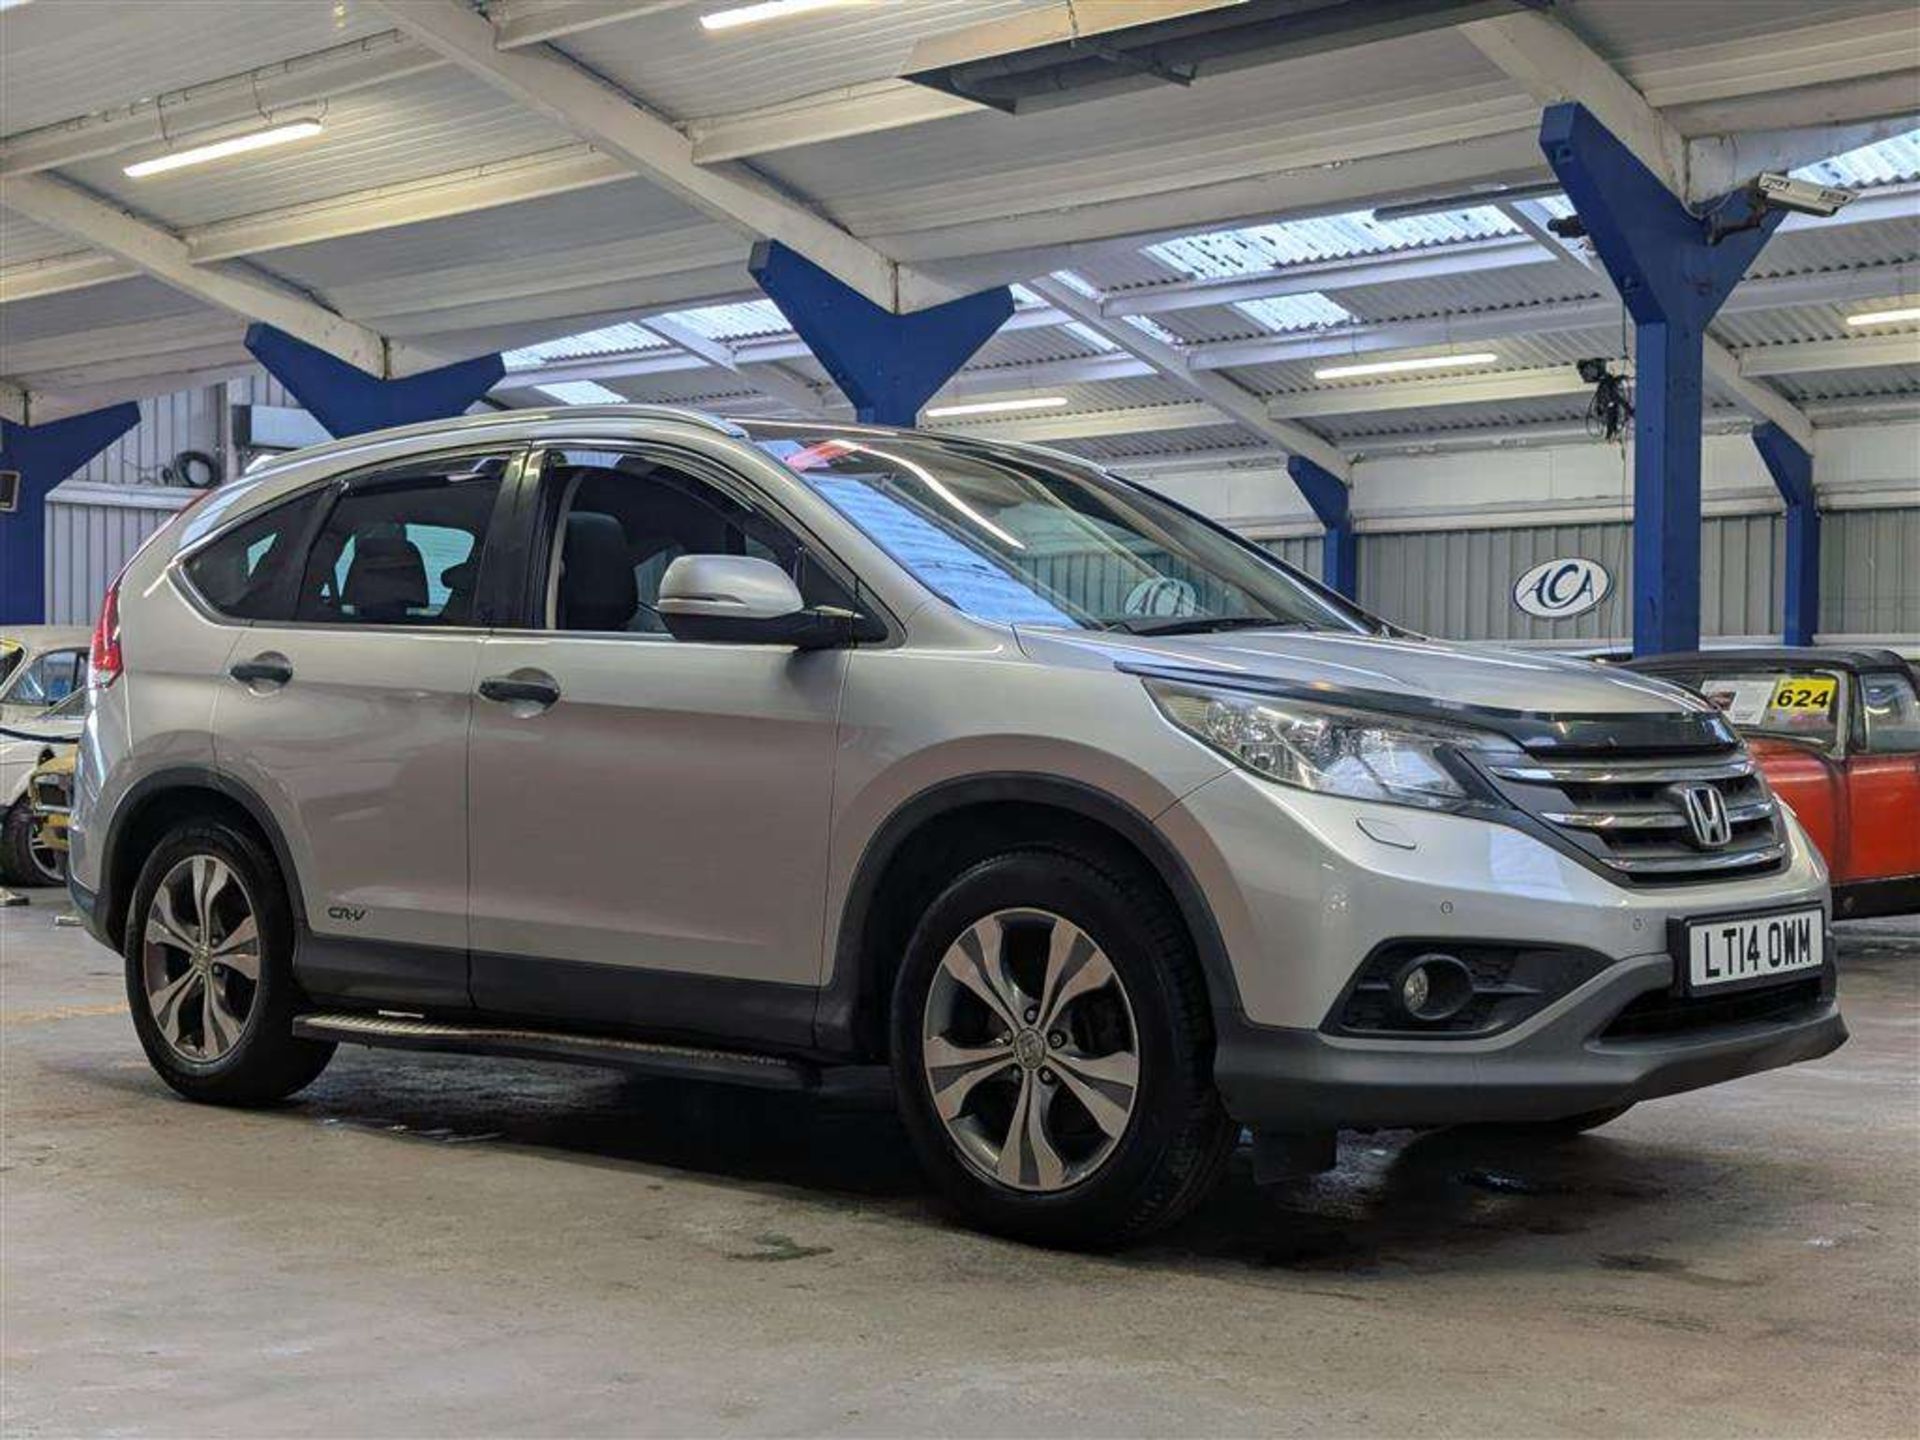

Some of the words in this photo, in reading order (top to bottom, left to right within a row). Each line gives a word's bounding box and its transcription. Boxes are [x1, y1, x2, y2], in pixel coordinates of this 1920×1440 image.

[1520, 563, 1595, 610] ACA
[1777, 689, 1830, 708] 624
[328, 906, 367, 921] CR-V
[1705, 925, 1760, 978] LT14
[1768, 917, 1812, 968] OWM
